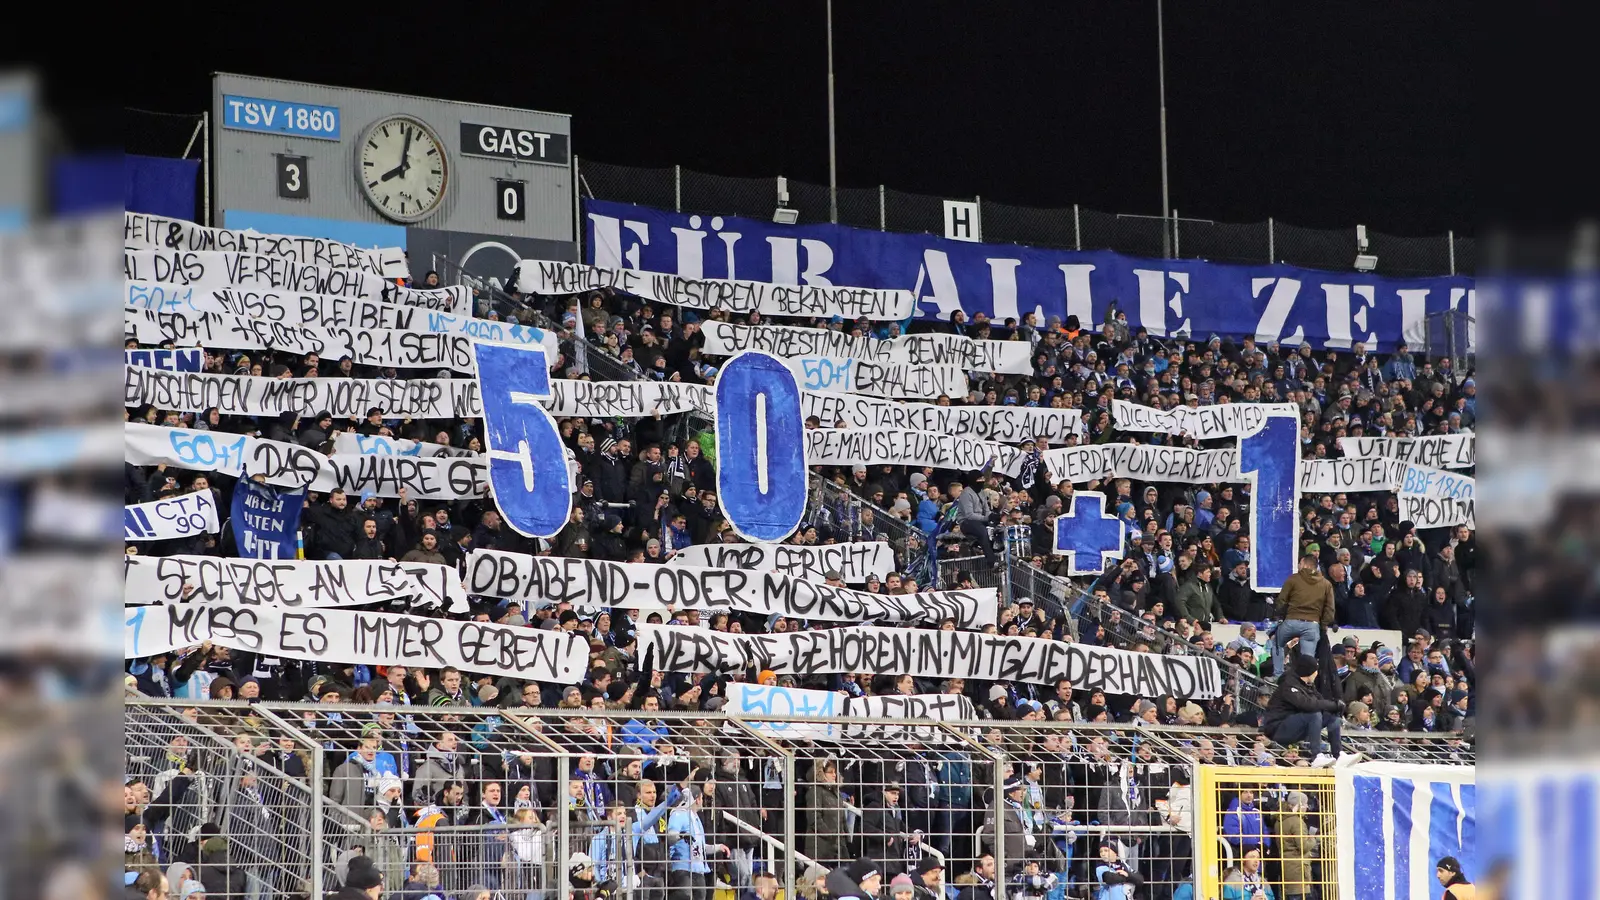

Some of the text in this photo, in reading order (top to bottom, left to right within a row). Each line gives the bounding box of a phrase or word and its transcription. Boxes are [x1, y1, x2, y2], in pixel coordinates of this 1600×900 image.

[228, 100, 336, 133] TSV 1860
[478, 126, 551, 158] GAST
[285, 163, 301, 191] 3
[503, 187, 518, 215] 0
[952, 206, 971, 238] H
[154, 252, 204, 285] DAS
[225, 253, 370, 298] VEREINSWOHL
[652, 274, 763, 312] INVESTOREN
[913, 248, 1191, 339] ALLE
[129, 285, 200, 312] 50+1
[212, 289, 285, 321] MUSS
[300, 295, 414, 330] BLEIBEN
[801, 358, 954, 397] 50+1 ERHALTEN!
[260, 380, 318, 415] IMMER
[327, 380, 371, 416] NOCH
[375, 379, 443, 416] SELBER
[574, 382, 645, 416] KARREN
[653, 383, 681, 412] AN
[1019, 412, 1073, 441] AUCH
[168, 430, 247, 471] 50+1
[254, 442, 321, 486] DAS
[327, 454, 442, 496] WAHRE
[155, 494, 212, 520] CTA
[308, 563, 355, 603] AM
[167, 603, 263, 652] MUSS
[279, 612, 328, 655] ES
[353, 613, 448, 666] IMMER
[458, 622, 574, 679] GEBEN!
[741, 686, 835, 736] 50+1
